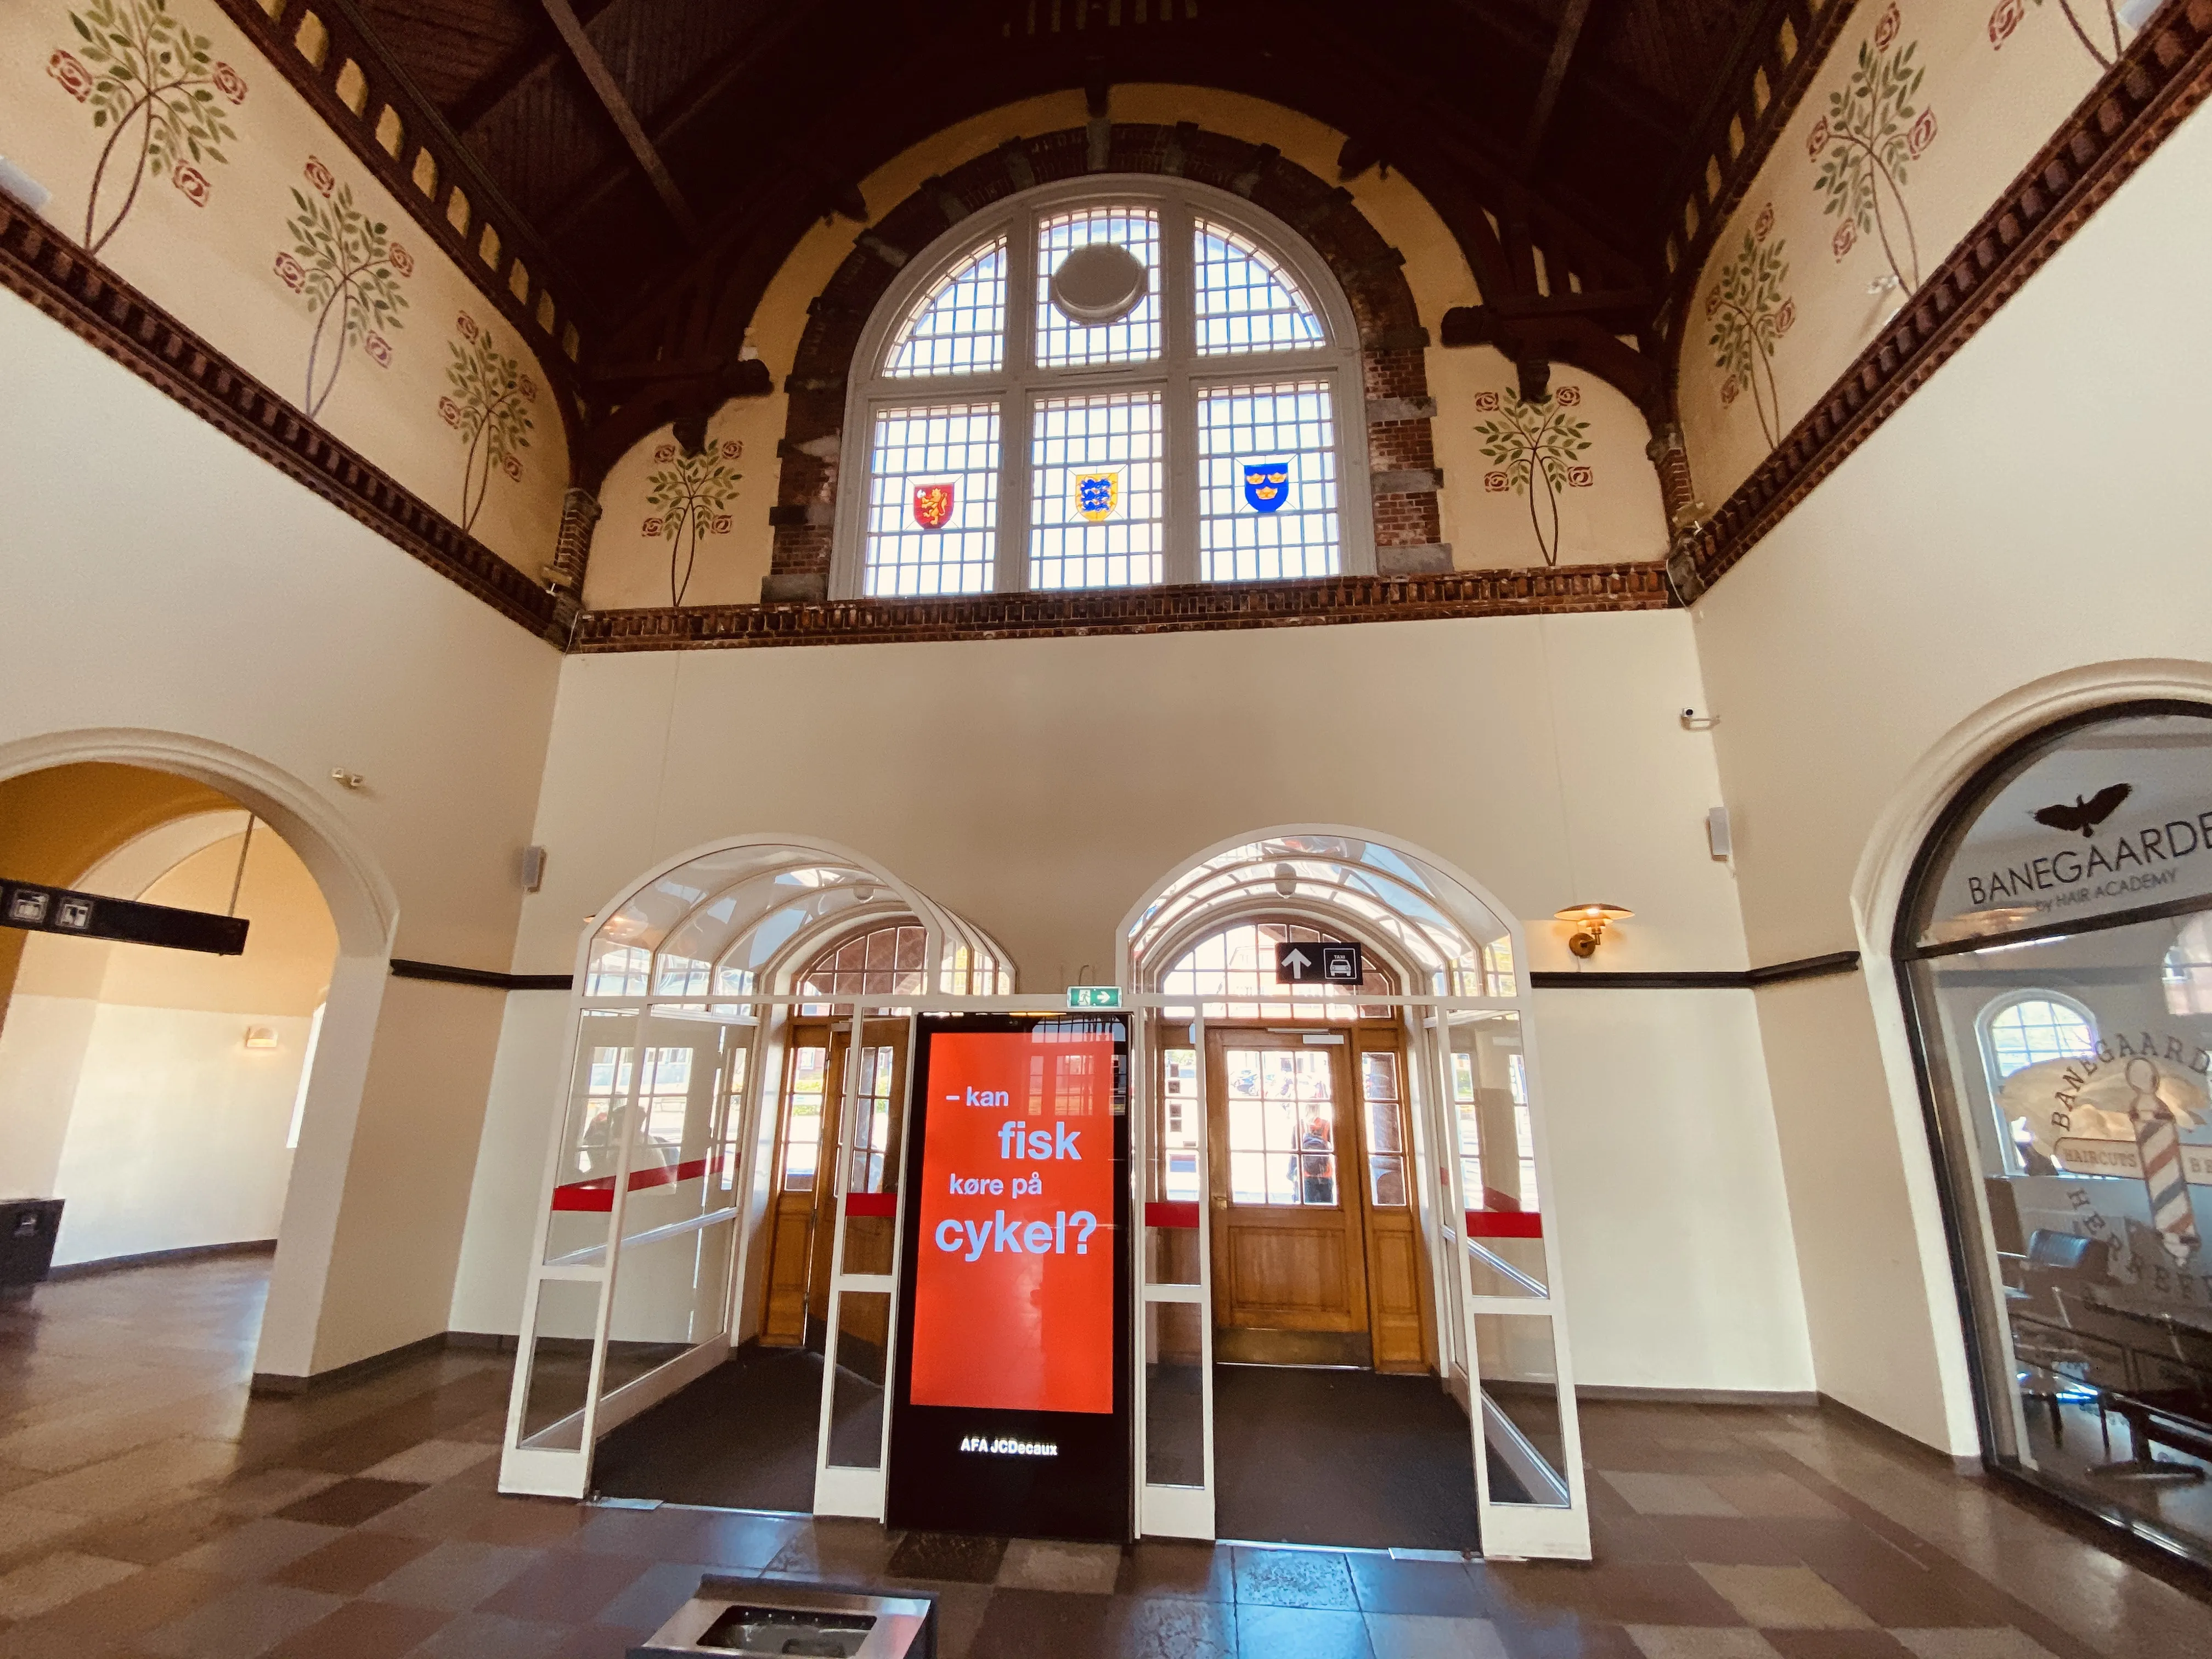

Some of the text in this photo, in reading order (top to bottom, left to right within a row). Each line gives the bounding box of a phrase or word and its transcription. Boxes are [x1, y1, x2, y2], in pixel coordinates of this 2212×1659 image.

[2056, 887, 2091, 907] HAIR
[2094, 867, 2177, 900] ACADEMY
[966, 1086, 1009, 1107] kan
[998, 1121, 1082, 1160] fisk
[2063, 1149, 2137, 1167] HAIRCUTS
[949, 1172, 1042, 1198] køre på
[934, 1210, 1097, 1262] cykel?
[961, 1438, 1057, 1455] AFA JCDecaux
